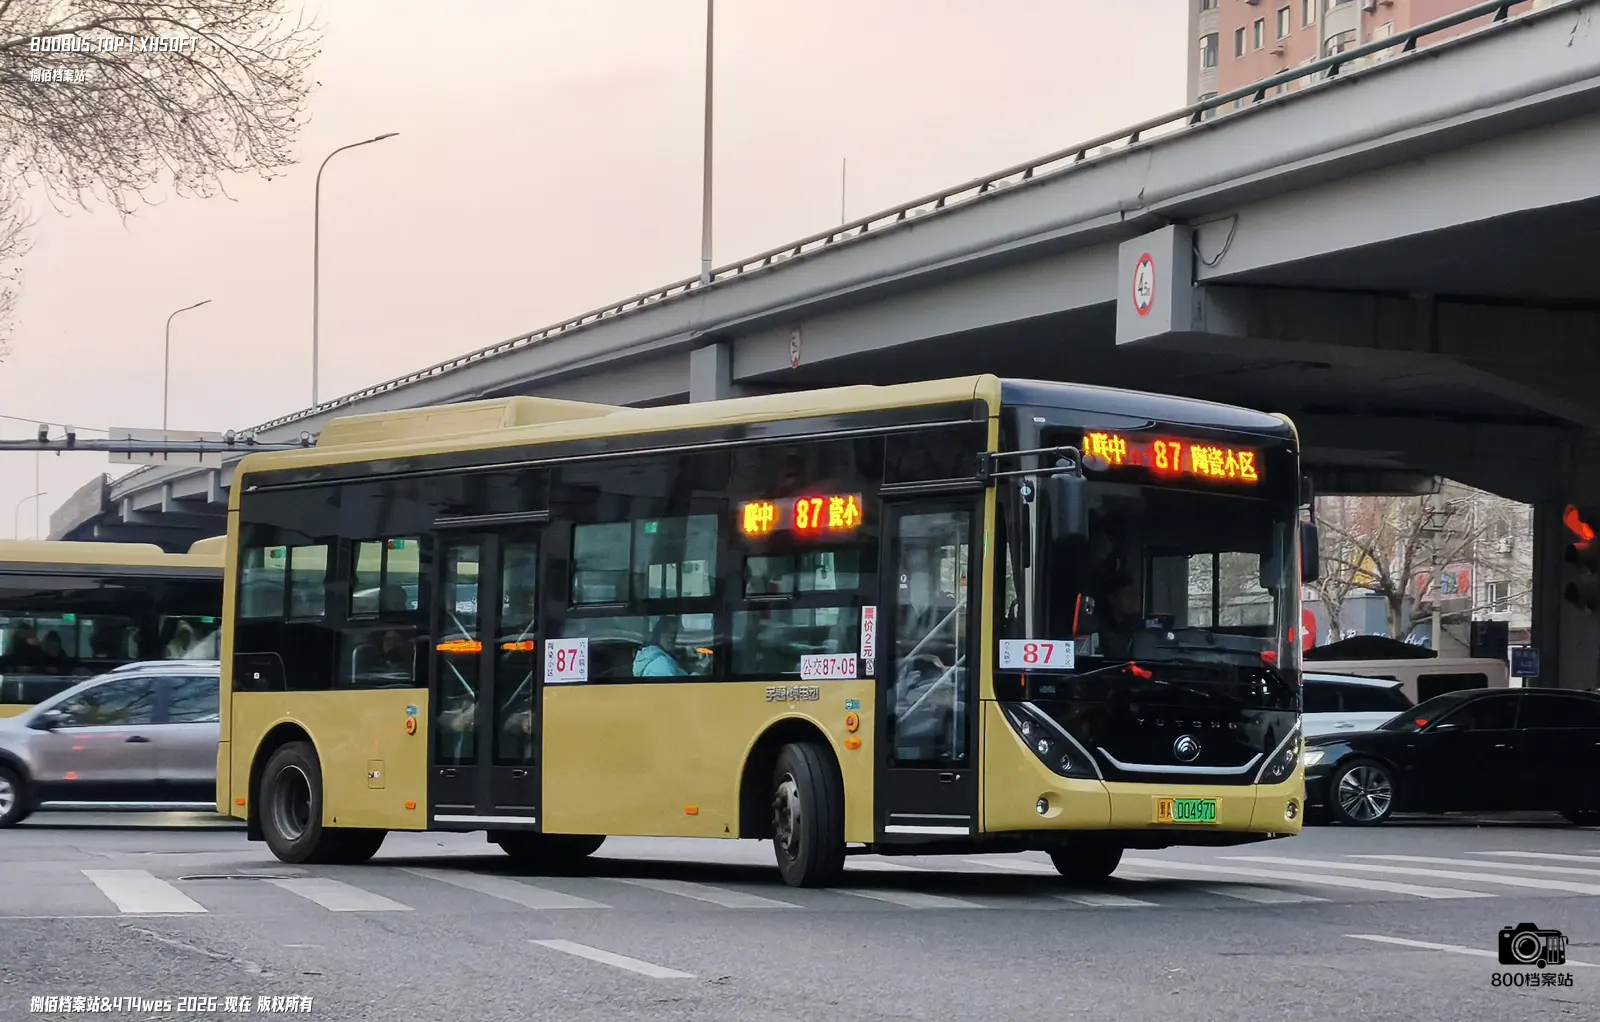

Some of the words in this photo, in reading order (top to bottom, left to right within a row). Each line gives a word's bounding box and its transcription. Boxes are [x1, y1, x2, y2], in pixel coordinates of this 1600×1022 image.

[1153, 440, 1182, 471] 87
[1190, 444, 1258, 481] 陶瓷小区
[796, 497, 823, 529] 87
[863, 607, 875, 658] 票价2元
[556, 648, 578, 672] 87
[1023, 643, 1055, 664] 87
